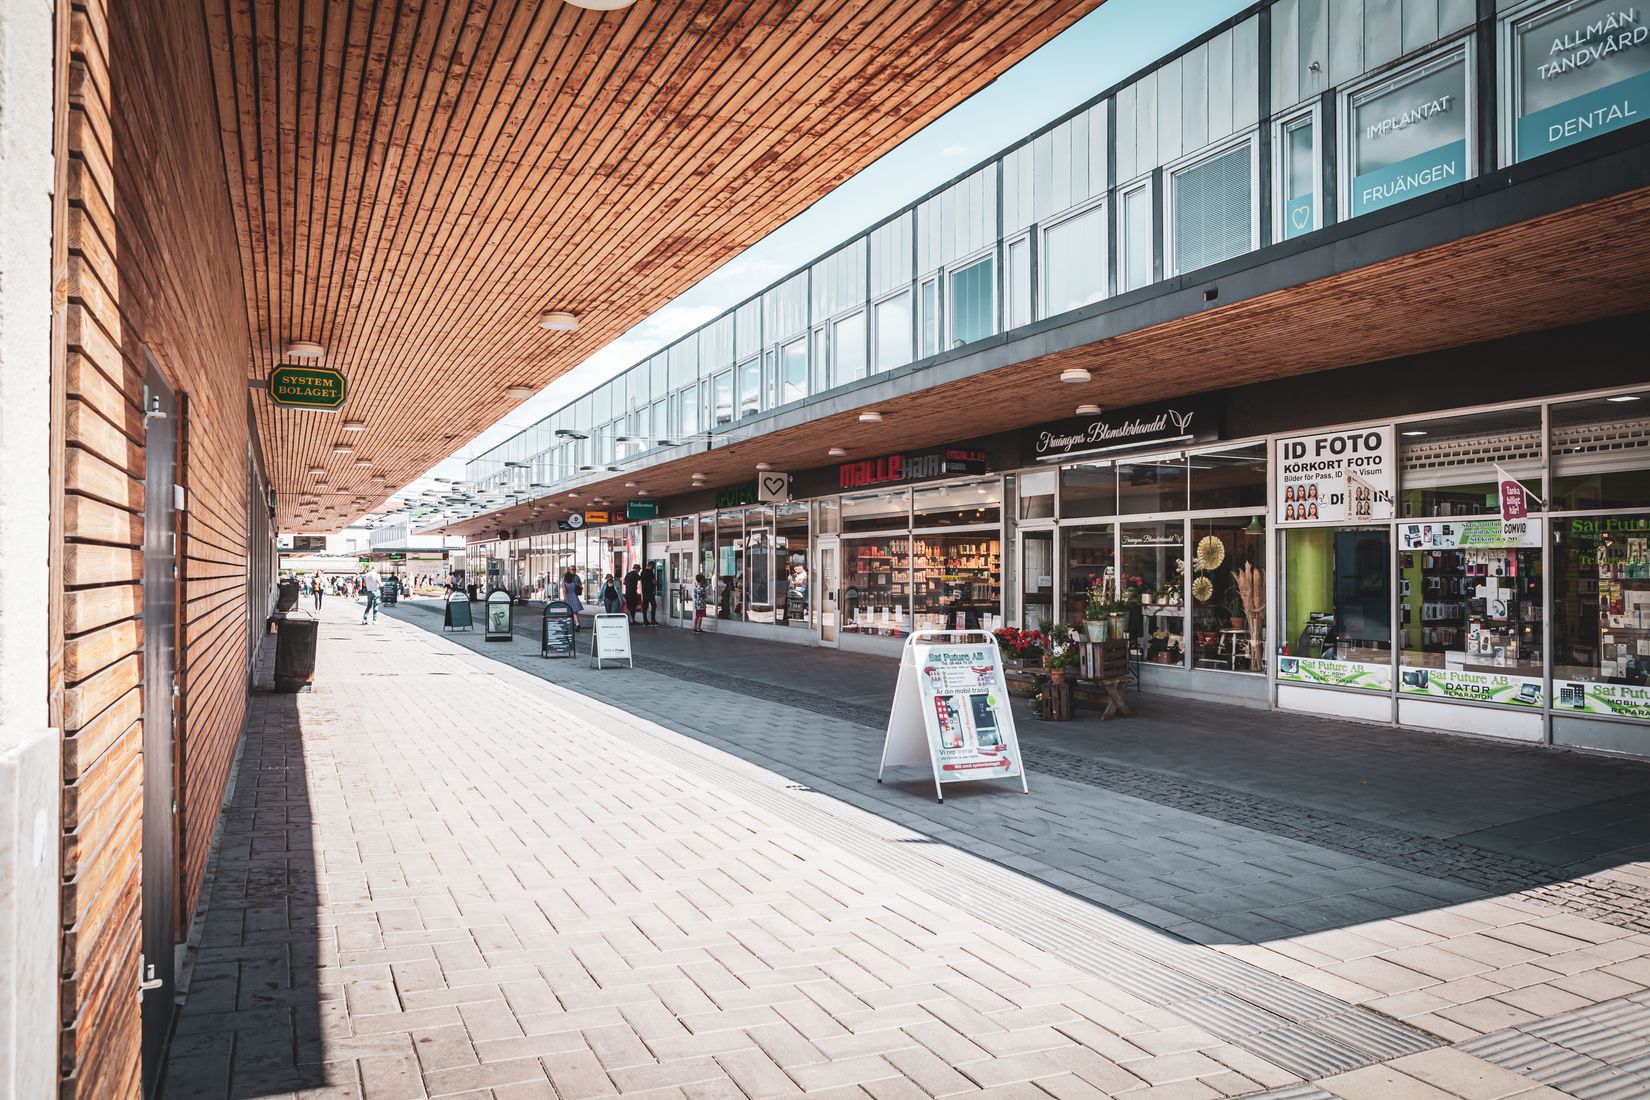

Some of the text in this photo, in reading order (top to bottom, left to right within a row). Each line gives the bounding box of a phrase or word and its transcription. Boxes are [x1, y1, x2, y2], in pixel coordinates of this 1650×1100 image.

[1549, 7, 1634, 56] ALLMÄN
[1537, 26, 1649, 80] TANDVÅRD
[1366, 95, 1450, 140] IMPLANTAT
[1549, 100, 1638, 143] DENTAL
[1362, 160, 1456, 205] FRUÄNGEN
[282, 375, 334, 387] SYSTEM
[279, 386, 337, 398] BOLAGET
[1036, 413, 1168, 453] Fruängens Blomsterhandel
[1283, 432, 1383, 461] ID FOTO
[1284, 460, 1344, 474] KÖRKORT
[1347, 455, 1383, 468] FOTO
[1284, 475, 1303, 483] Bilder
[1315, 472, 1333, 480] Pass,
[1335, 470, 1343, 478] ID
[1359, 468, 1382, 476] Visum
[1505, 486, 1521, 495] Tanka
[1503, 522, 1527, 535] COMVIQ
[1571, 519, 1599, 532] Sat
[928, 651, 984, 662] Sat Future AB
[1301, 659, 1365, 673] Sat Future AB
[1429, 670, 1447, 680] Sat
[1450, 671, 1487, 684] Future
[1491, 675, 1509, 686] AB
[1443, 690, 1493, 700] REPARATION
[1445, 683, 1490, 694] DATOR
[1592, 684, 1616, 697] Sat
[1607, 698, 1638, 707] MOBIL
